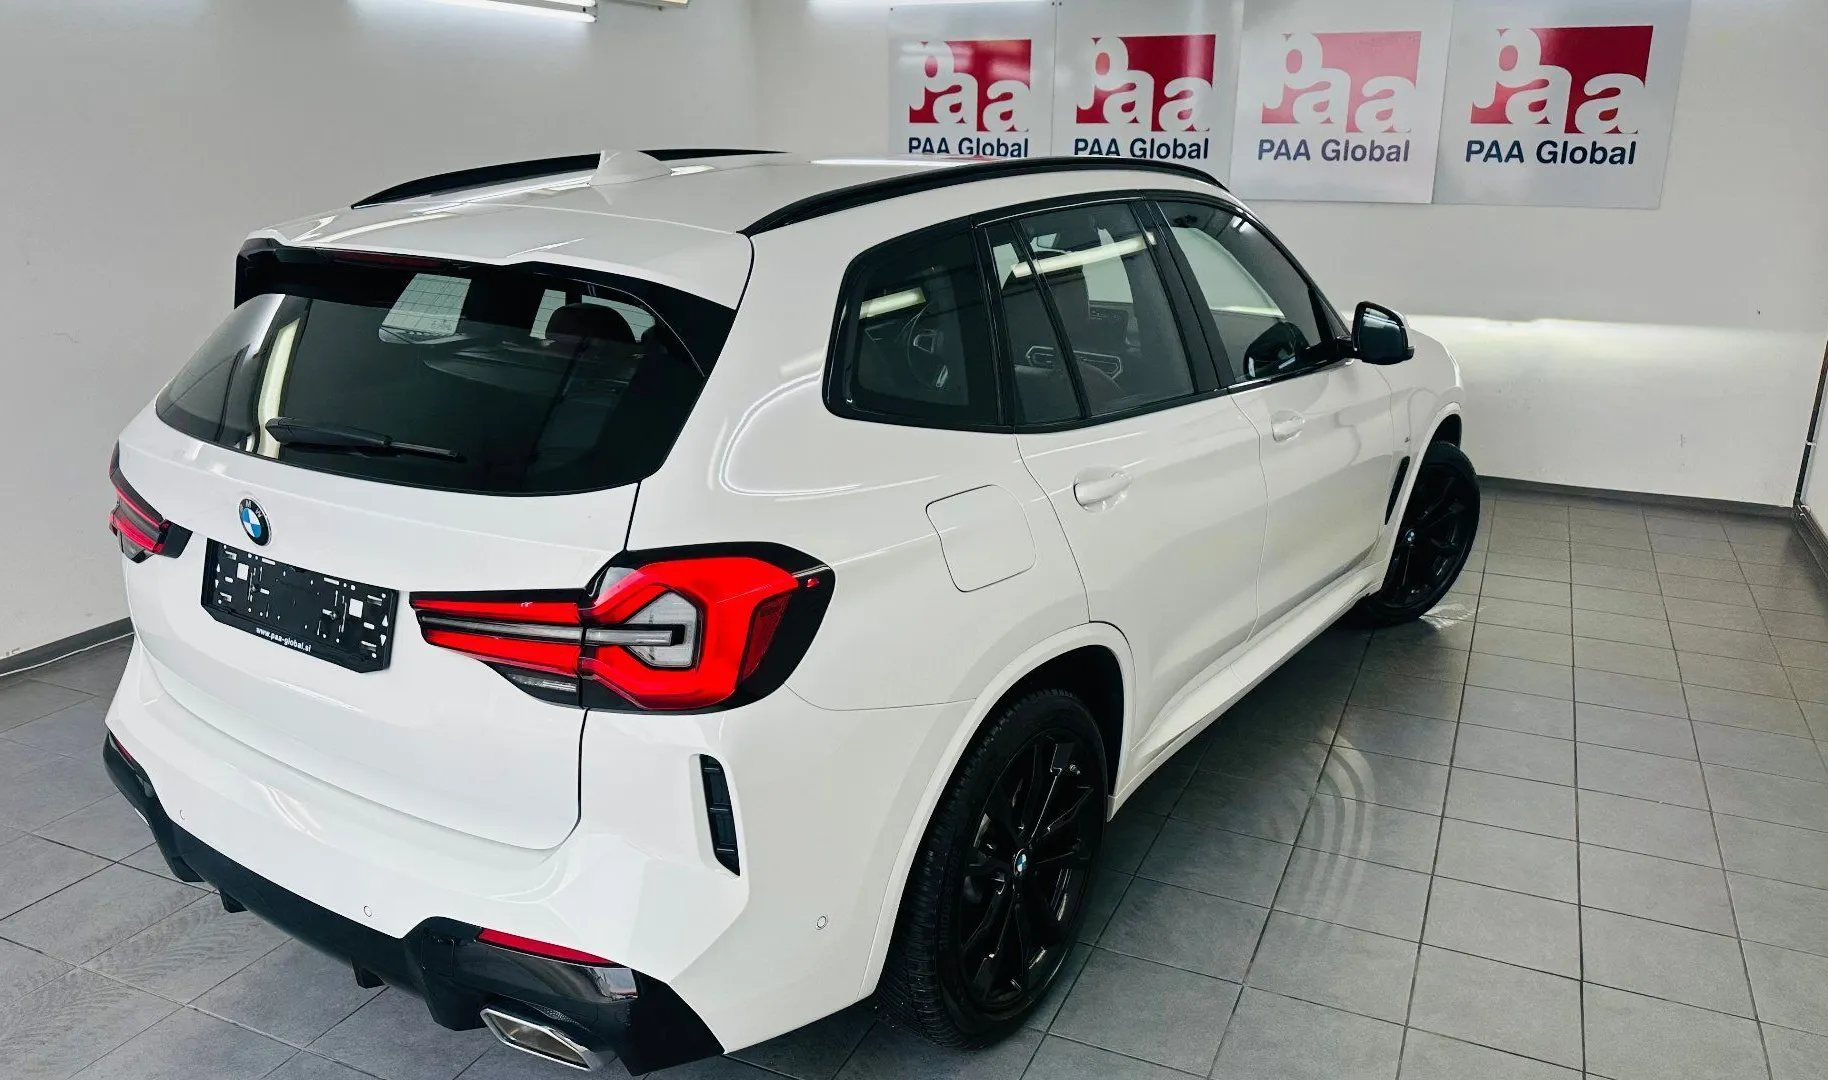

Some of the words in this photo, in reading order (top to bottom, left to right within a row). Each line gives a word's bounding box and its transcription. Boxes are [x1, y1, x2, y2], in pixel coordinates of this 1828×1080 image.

[908, 136, 950, 154] PAA
[957, 136, 1029, 158] Global
[1074, 137, 1121, 156] PAA
[1129, 137, 1209, 159] Global
[1257, 138, 1311, 161] PAA
[1320, 138, 1410, 162] Global
[1465, 139, 1525, 163] PAA
[1535, 139, 1637, 165] Global
[255, 627, 312, 652] www.paa-global.si
